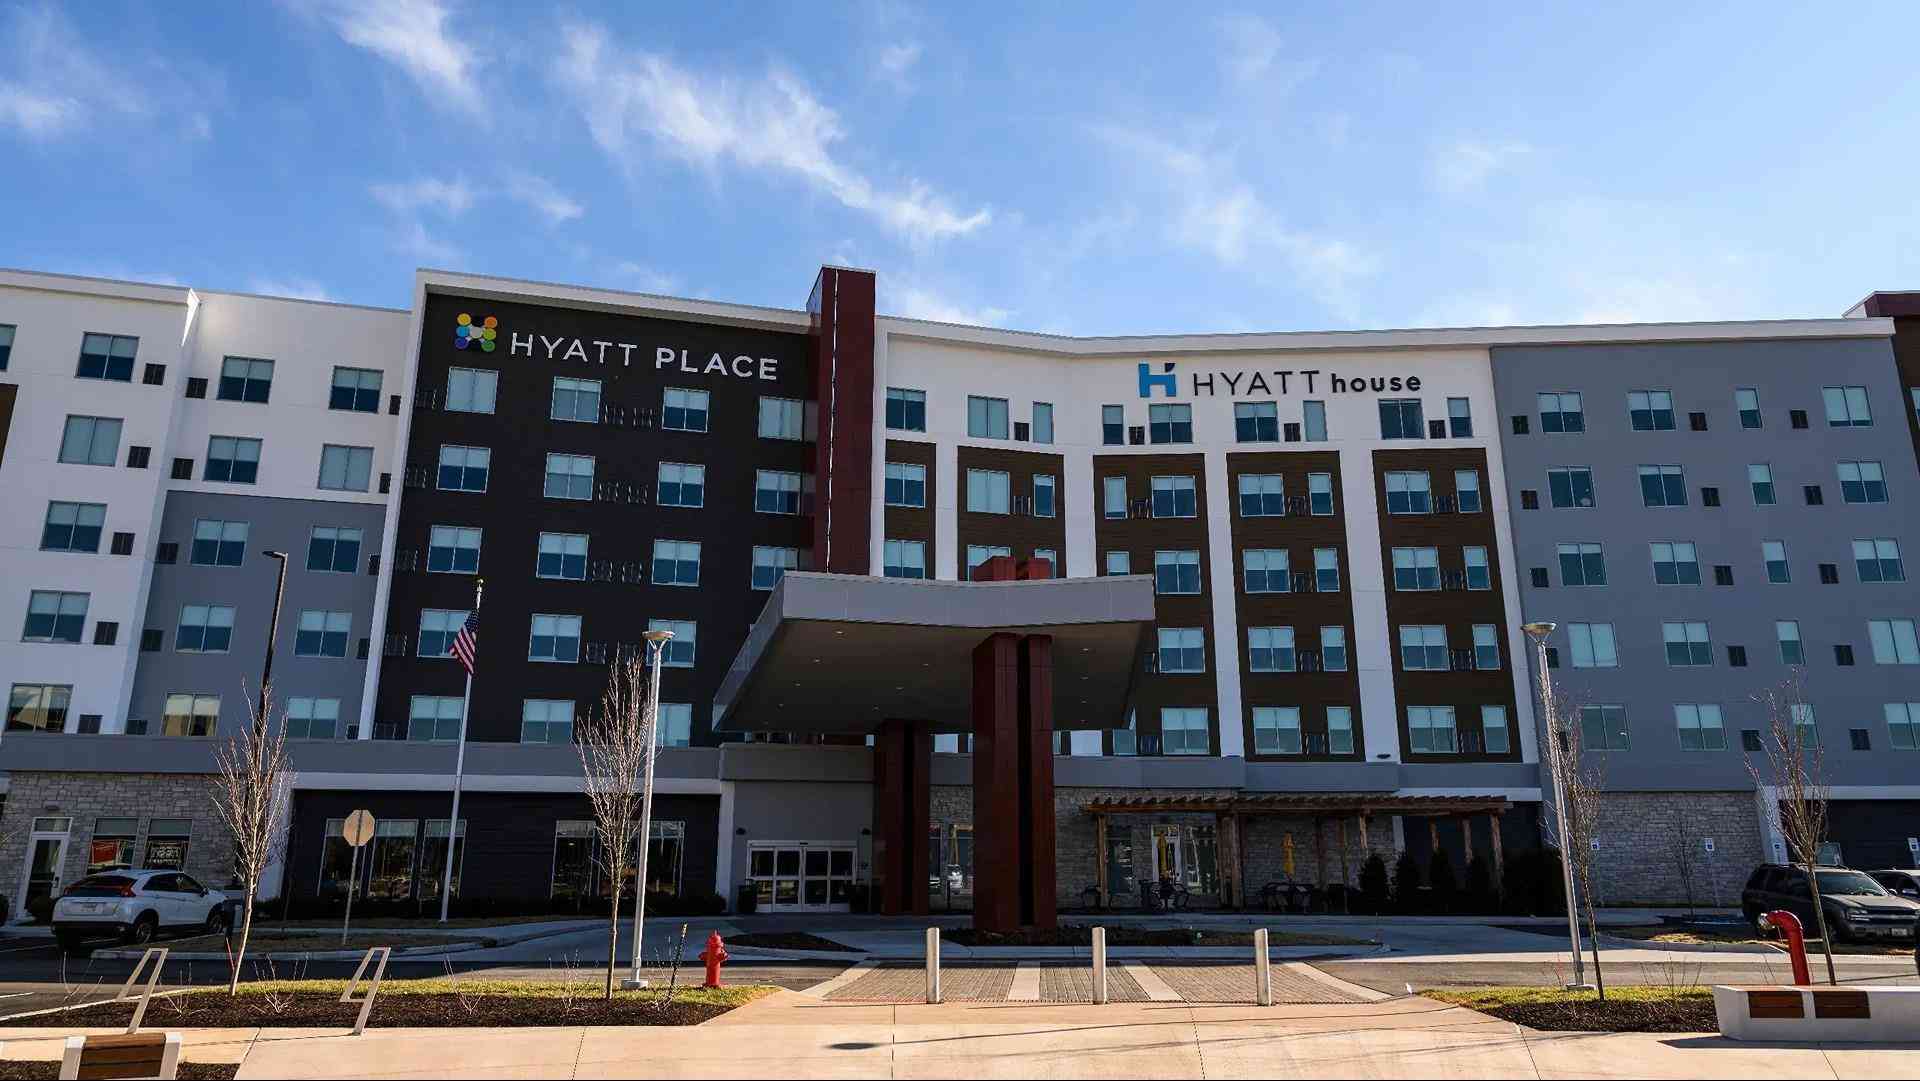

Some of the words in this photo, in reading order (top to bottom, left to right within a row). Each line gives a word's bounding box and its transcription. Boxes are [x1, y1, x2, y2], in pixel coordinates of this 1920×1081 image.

[510, 332, 638, 366] HYATT
[655, 347, 778, 381] PLACE
[1193, 370, 1320, 396] HYATT
[1331, 372, 1422, 393] house
